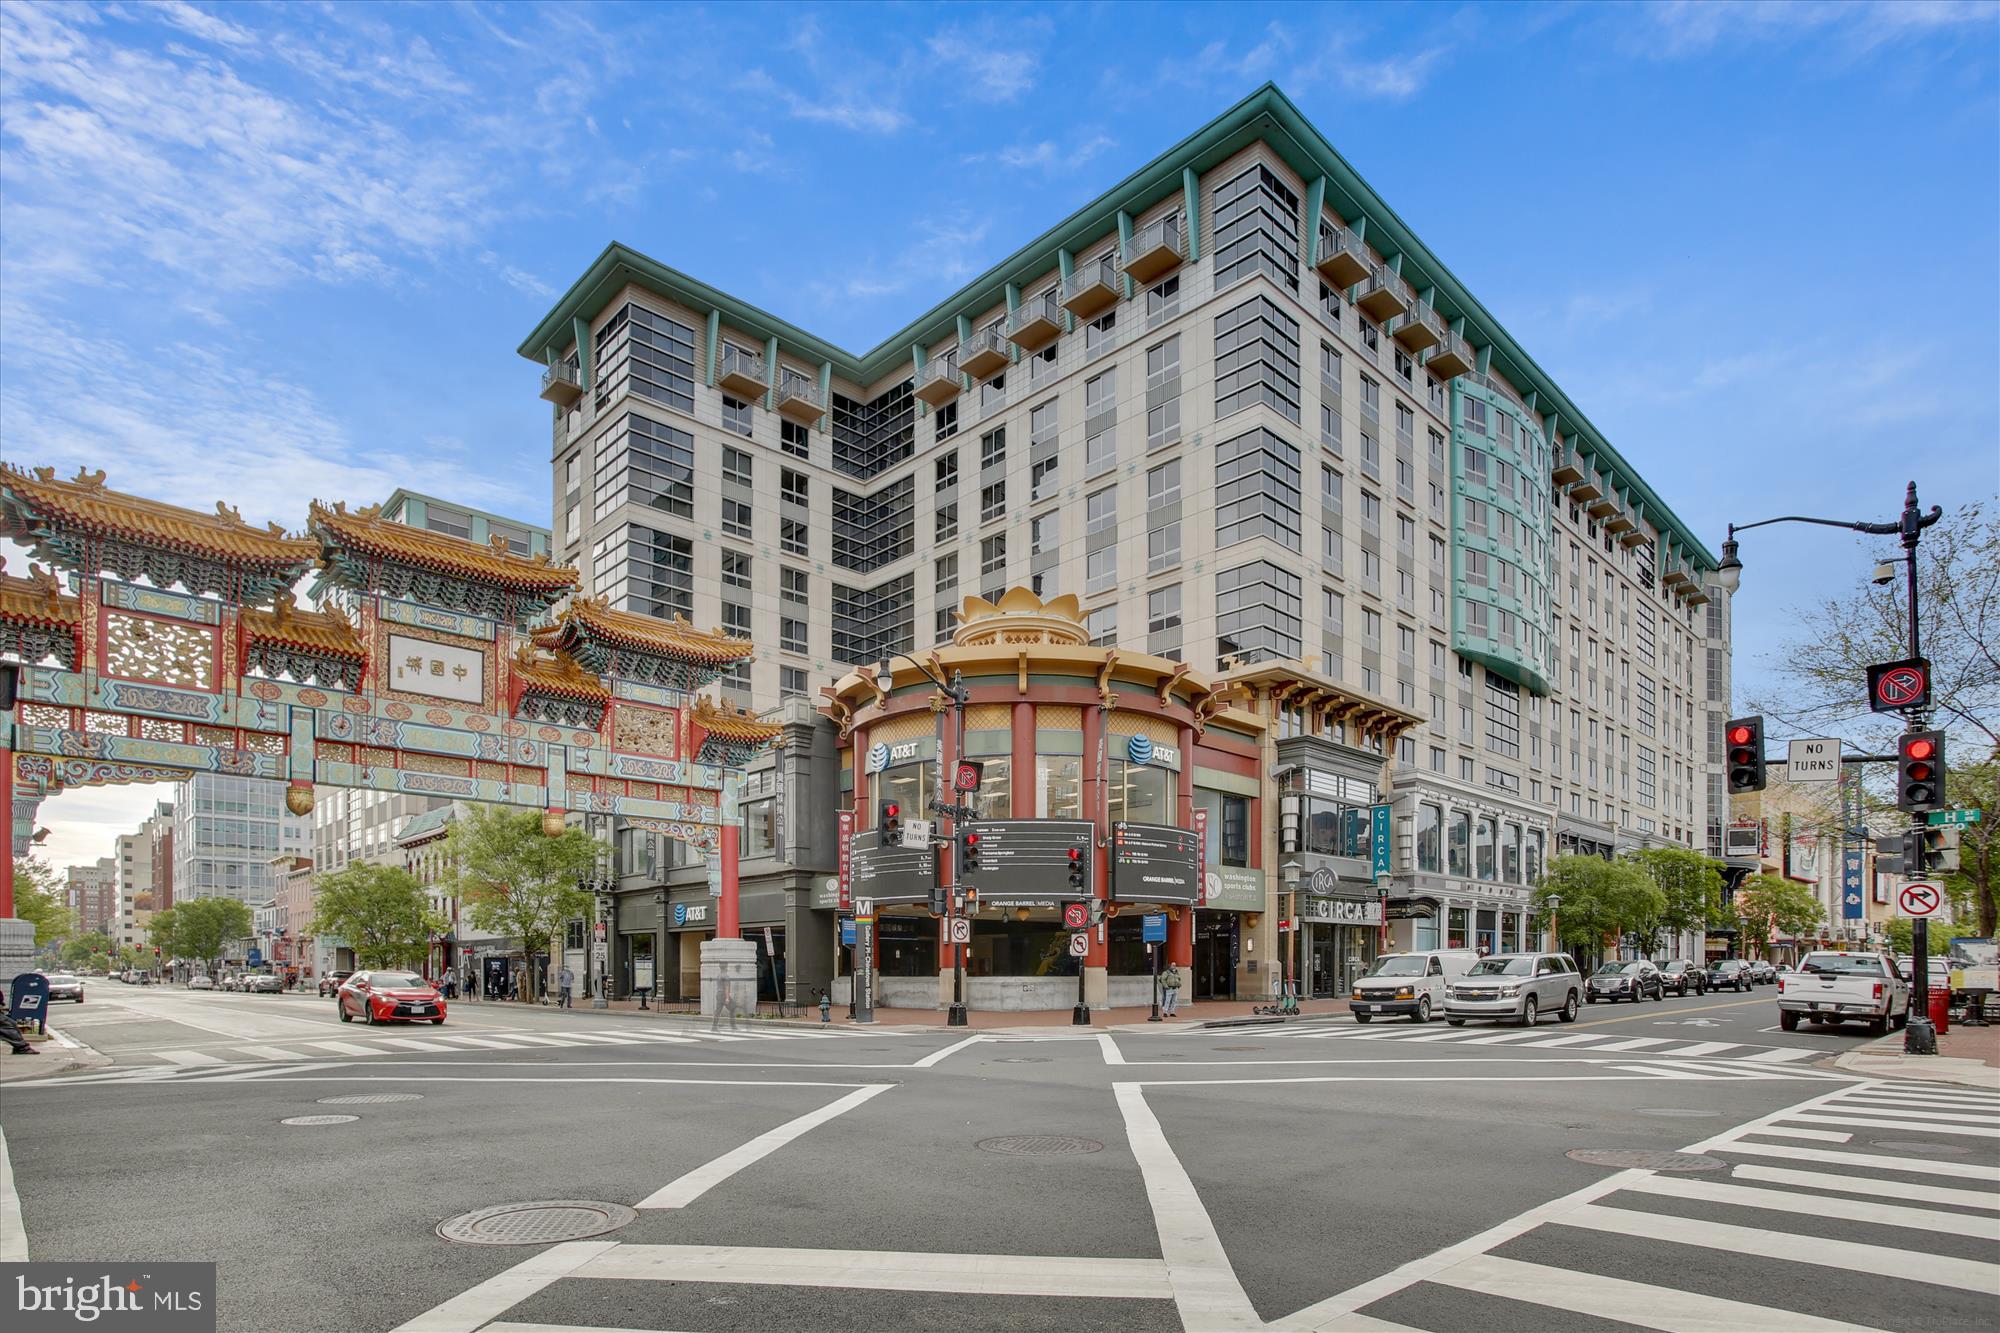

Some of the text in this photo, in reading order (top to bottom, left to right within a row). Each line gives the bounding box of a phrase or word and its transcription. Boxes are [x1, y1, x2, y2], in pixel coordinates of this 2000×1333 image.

[890, 743, 918, 760] AT&T
[1152, 746, 1174, 763] AT&T
[1806, 743, 1823, 754] NO
[1794, 760, 1834, 771] TURNS
[1944, 812, 1957, 823] H
[906, 833, 926, 842] TURNS
[1377, 811, 1385, 867] CIRCA
[1223, 871, 1256, 882] washington
[1224, 882, 1256, 891] sports clubs
[686, 905, 707, 921] AT&T
[856, 901, 870, 915] M
[1318, 901, 1364, 920] CIRCA
